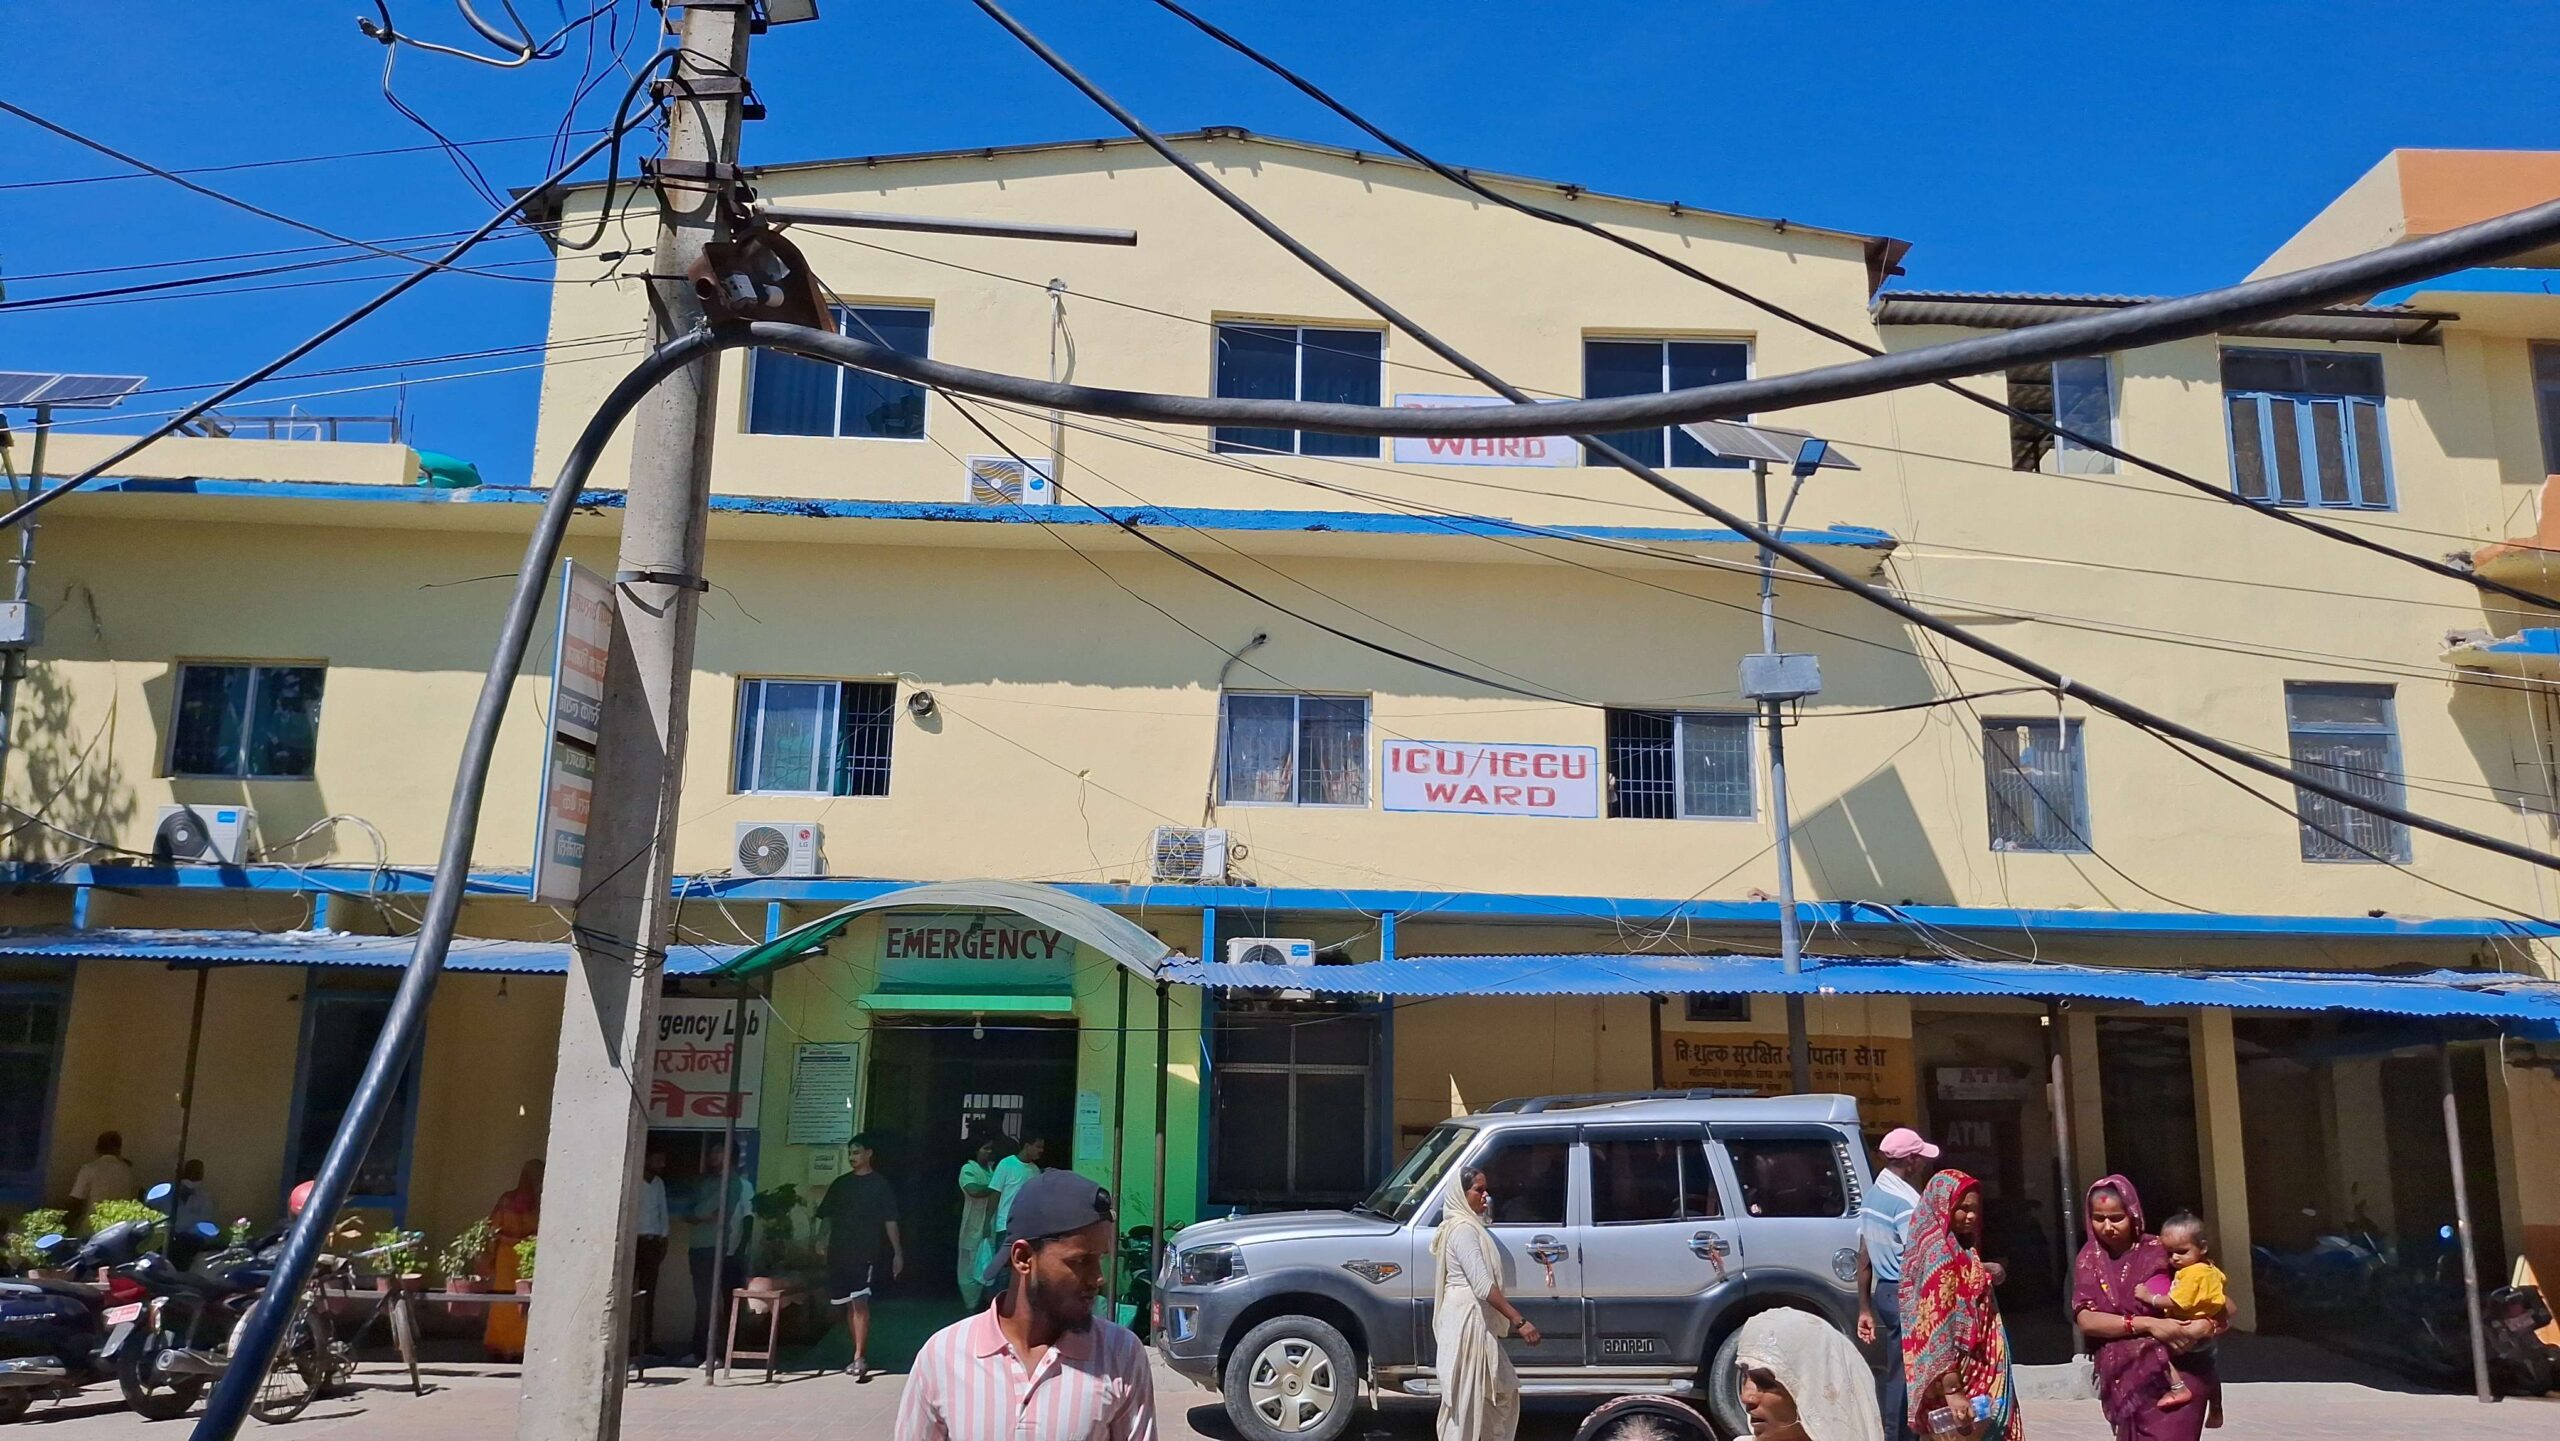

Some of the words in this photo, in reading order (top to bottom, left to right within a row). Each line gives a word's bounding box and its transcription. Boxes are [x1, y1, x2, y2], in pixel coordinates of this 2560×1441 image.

[1426, 436, 1547, 459] WARD
[1391, 747, 1587, 780] ICU/ICCU
[1424, 782, 1556, 808] WARD
[886, 927, 1063, 960] EMERGENCY
[658, 1014, 719, 1042] gency
[723, 1009, 759, 1036] Lb
[1732, 1040, 1783, 1067] सुरक्षित
[1947, 1120, 1992, 1147] ATM
